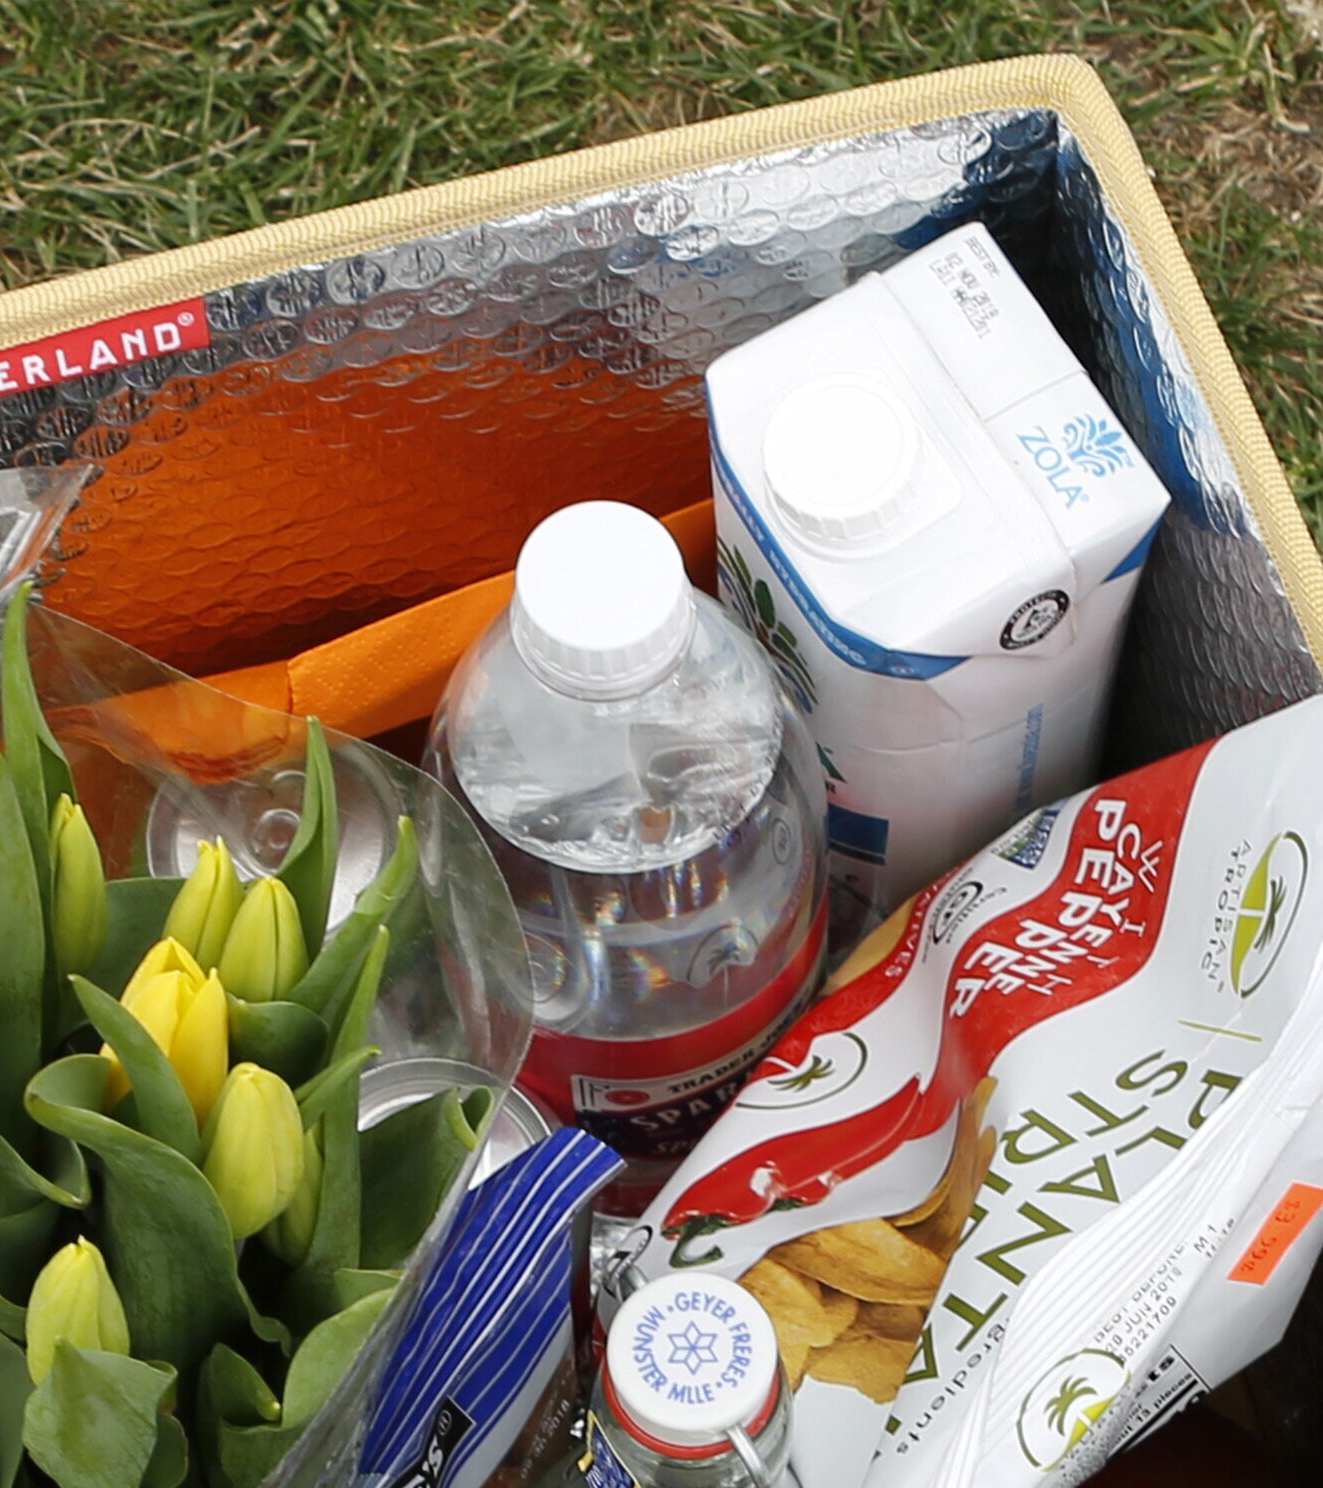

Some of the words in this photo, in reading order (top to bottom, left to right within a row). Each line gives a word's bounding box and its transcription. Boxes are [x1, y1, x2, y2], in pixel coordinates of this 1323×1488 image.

[1016, 424, 1083, 509] ZOLA
[949, 799, 1128, 1018] PEPPER
[983, 822, 1142, 996] CAYENNE
[1026, 840, 1164, 996] WITH
[1200, 844, 1244, 971] TROPIC
[1207, 838, 1253, 981] ARTISAN
[667, 1049, 756, 1094] TRADER
[632, 1305, 668, 1393] MUNSTER
[666, 1382, 716, 1405] MLLE
[674, 1291, 737, 1324] GEYER
[721, 1321, 752, 1388] FRERES
[895, 1318, 1005, 1455] gredients
